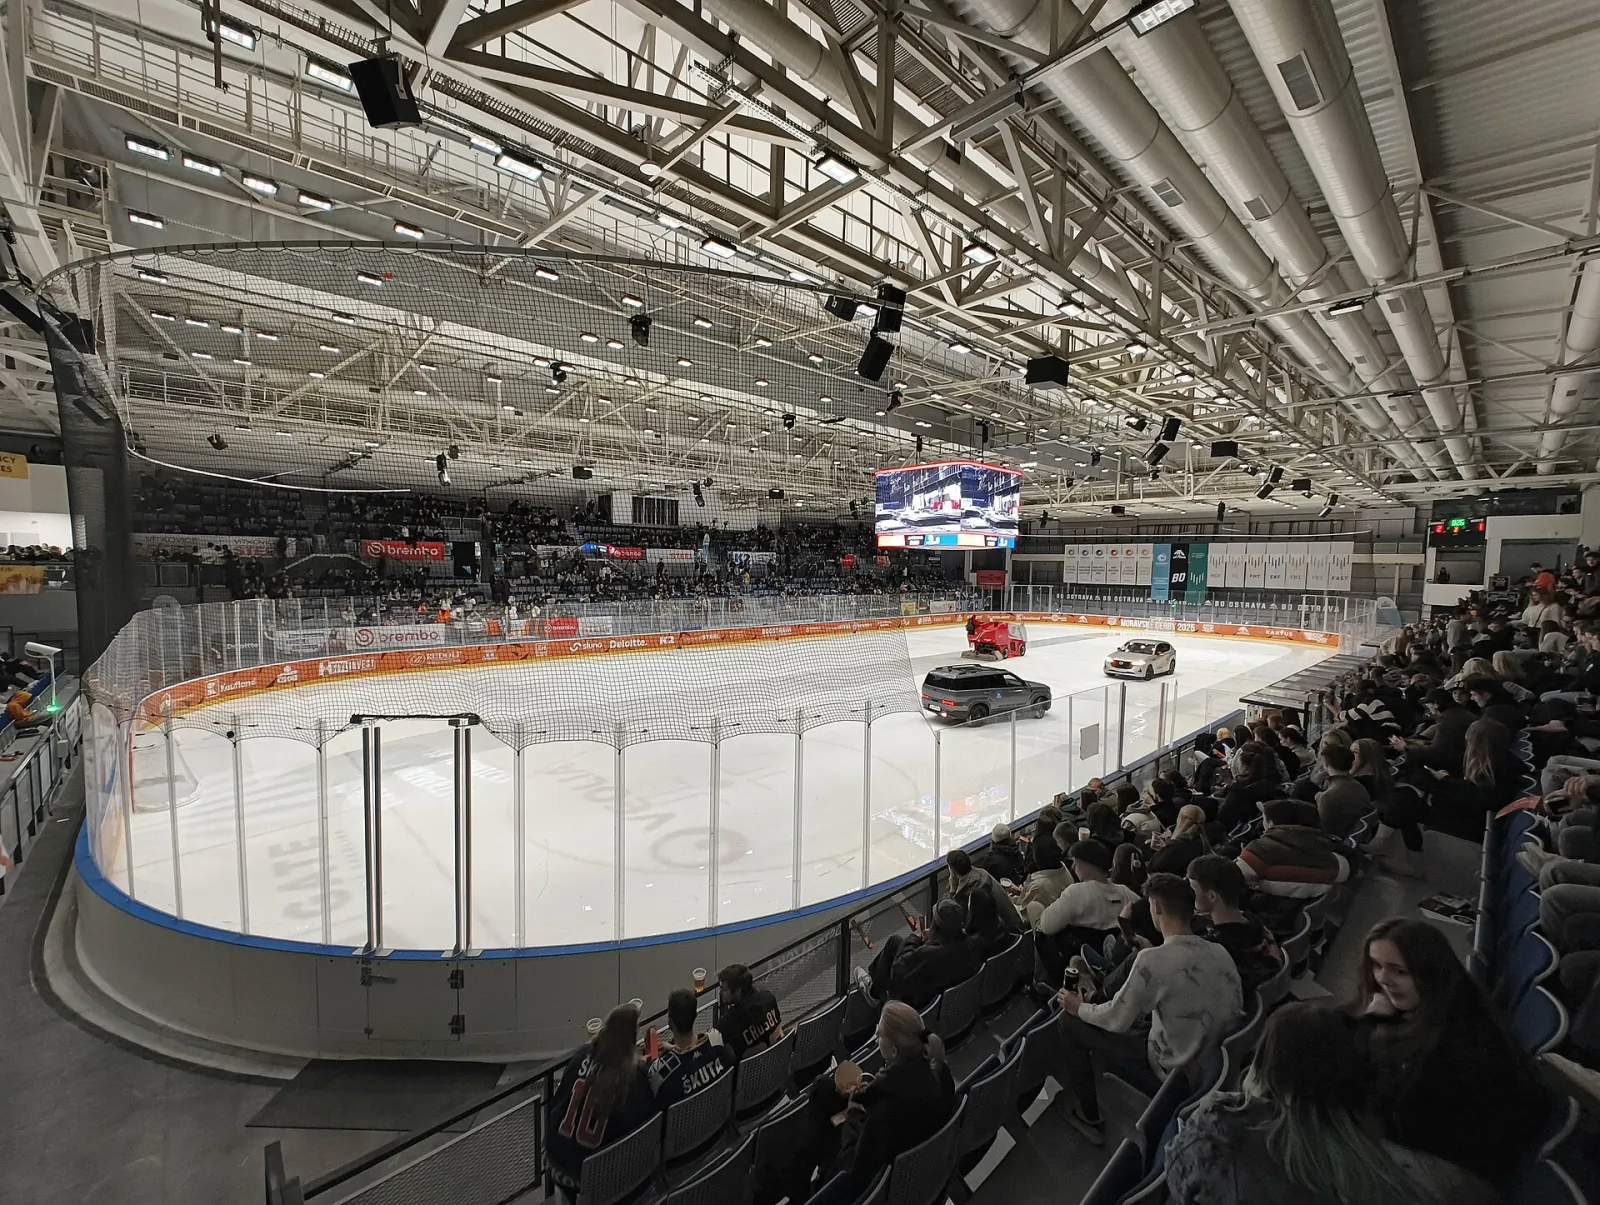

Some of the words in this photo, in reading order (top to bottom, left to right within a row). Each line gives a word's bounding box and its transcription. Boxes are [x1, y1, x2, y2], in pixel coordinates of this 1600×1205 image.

[387, 545, 439, 556] brembo
[1113, 596, 1144, 604] OSTRAVA
[1228, 601, 1267, 610] OSTRAVA
[1297, 604, 1340, 613] OSTRAVA
[1155, 620, 1177, 631] DERBY
[1177, 622, 1196, 633] 2025
[378, 629, 439, 644] brembo
[659, 635, 675, 645] K2
[220, 678, 257, 693] Kaufland
[682, 1057, 725, 1095] ŠKUTA
